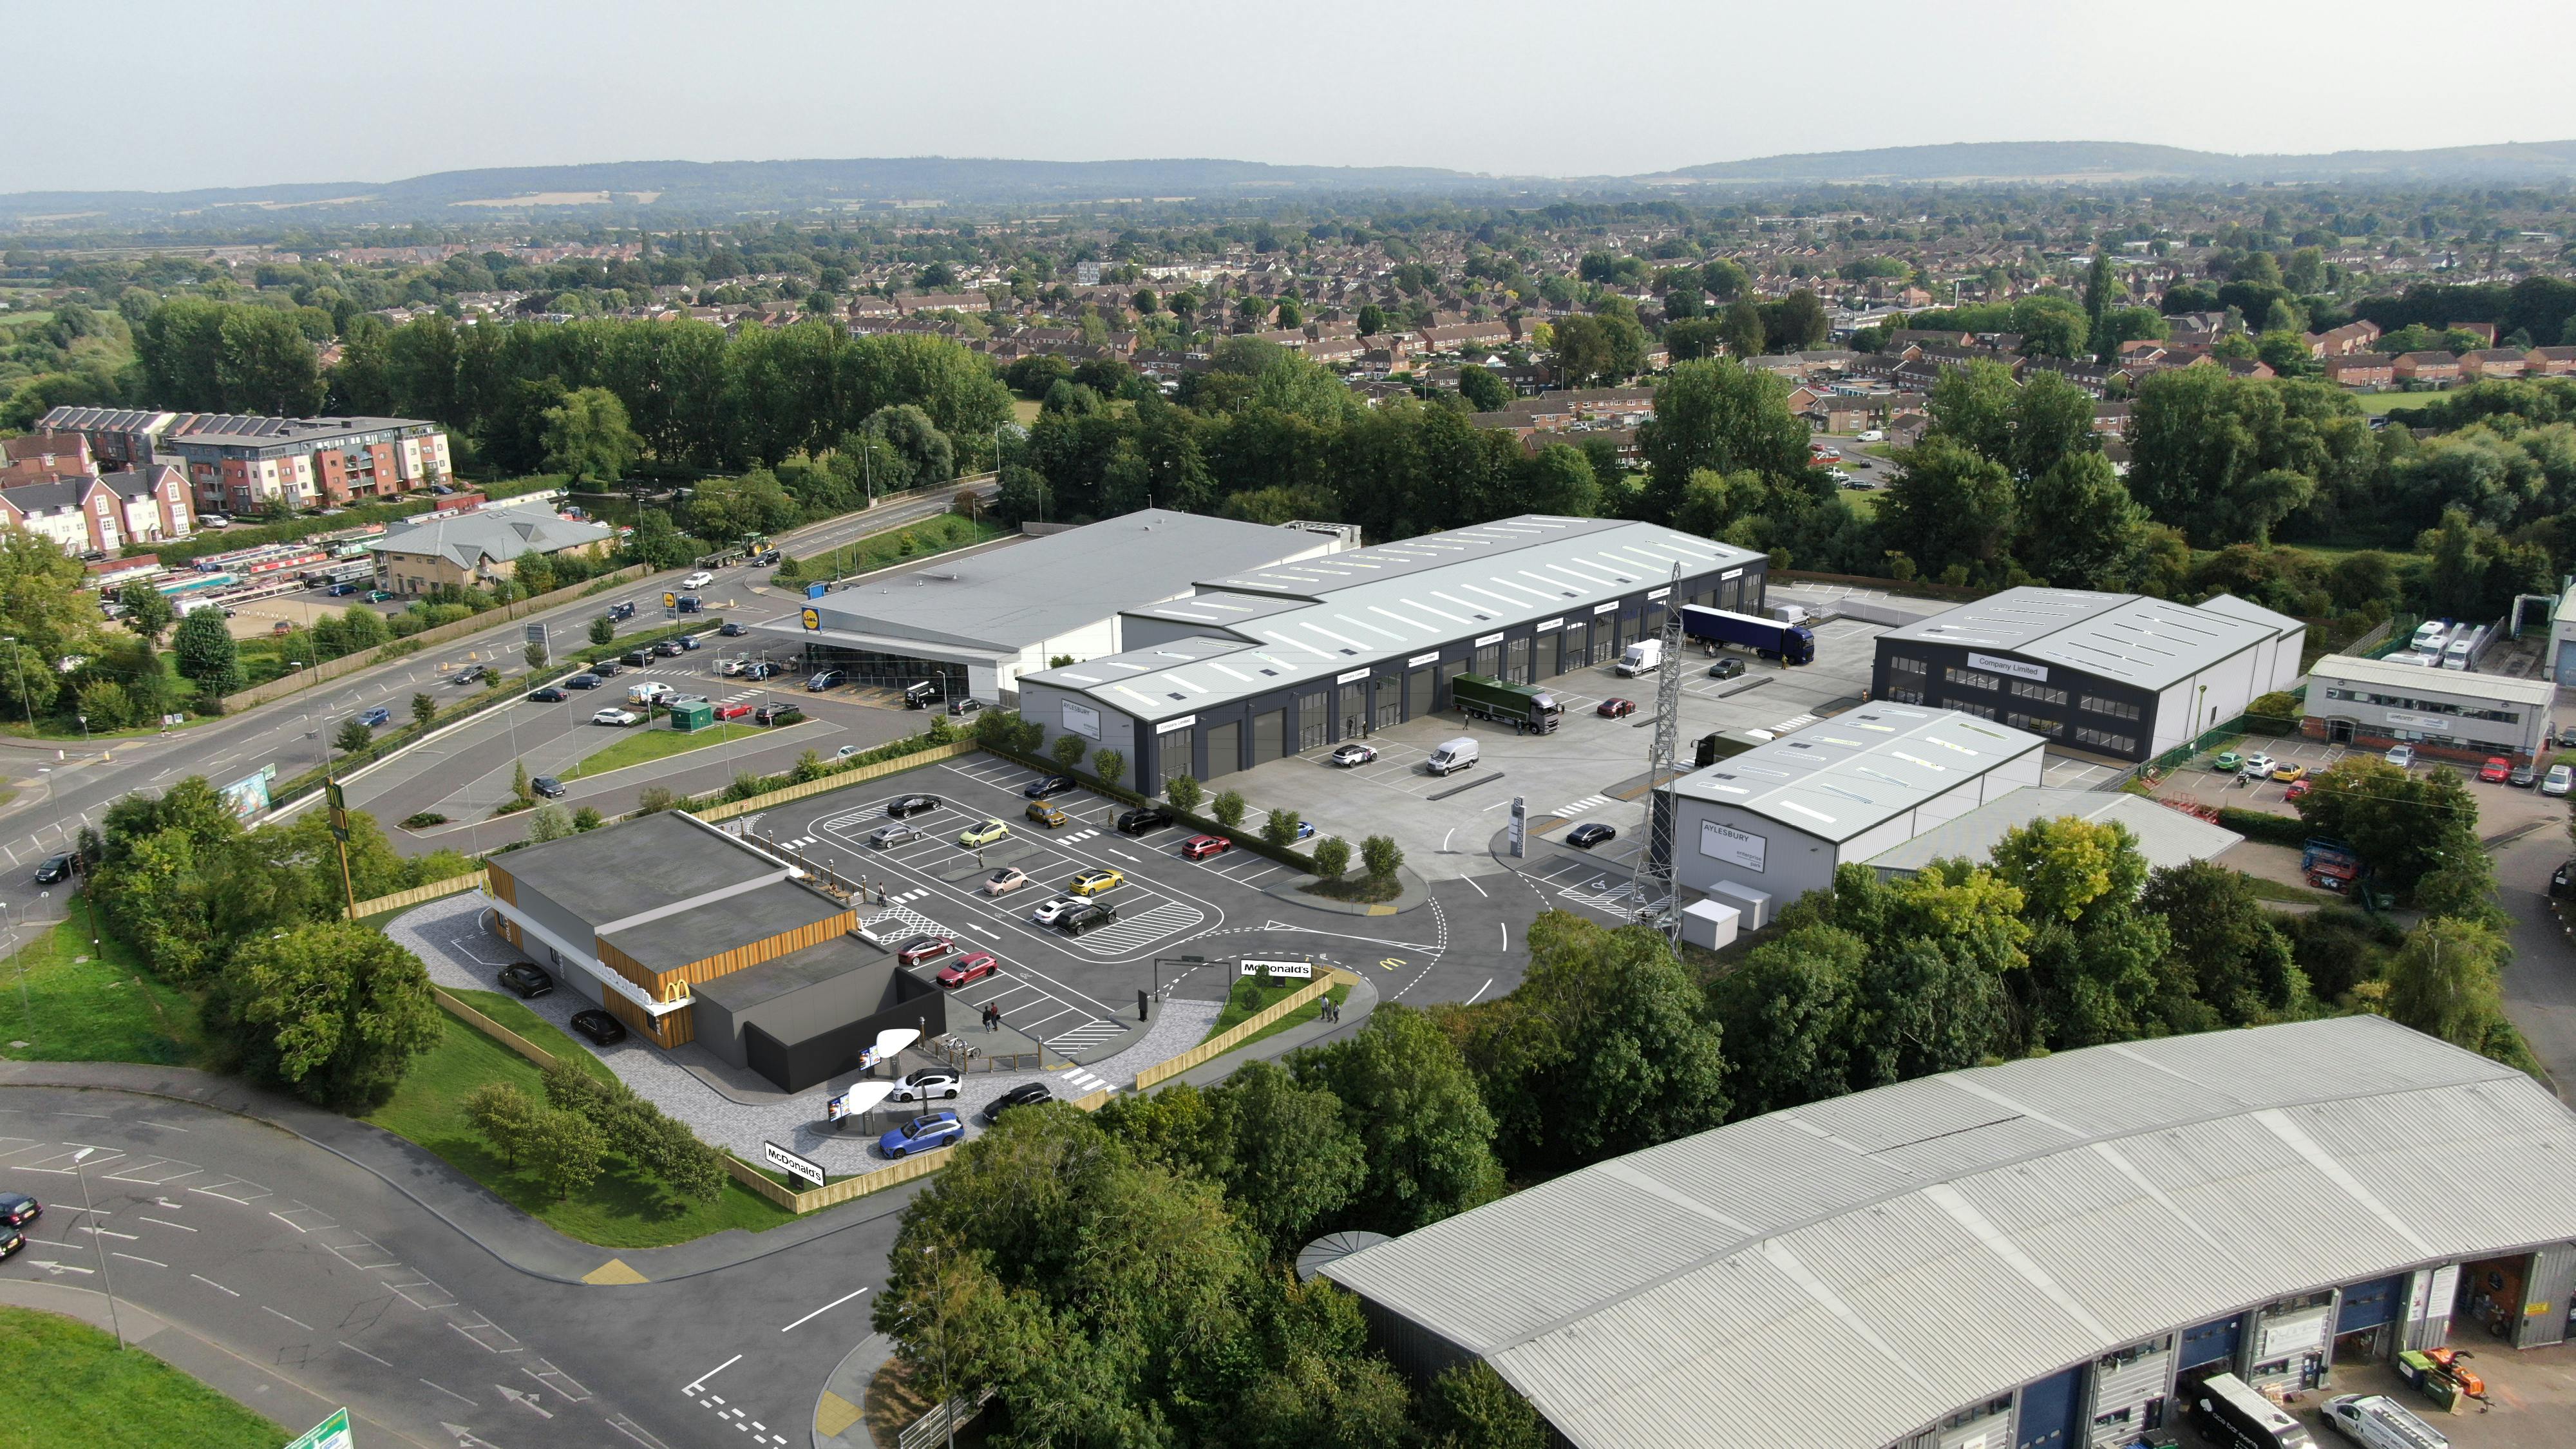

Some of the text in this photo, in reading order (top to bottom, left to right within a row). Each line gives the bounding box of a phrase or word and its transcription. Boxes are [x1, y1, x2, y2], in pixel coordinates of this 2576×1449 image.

[1979, 658, 2038, 675] Company Limited
[1063, 702, 1090, 715] AYLESBURY
[1704, 824, 1749, 842] AYLESBURY
[1736, 851, 1762, 862] enterprise
[1244, 963, 1309, 974] Mconald's
[768, 1148, 821, 1181] McDonald's
